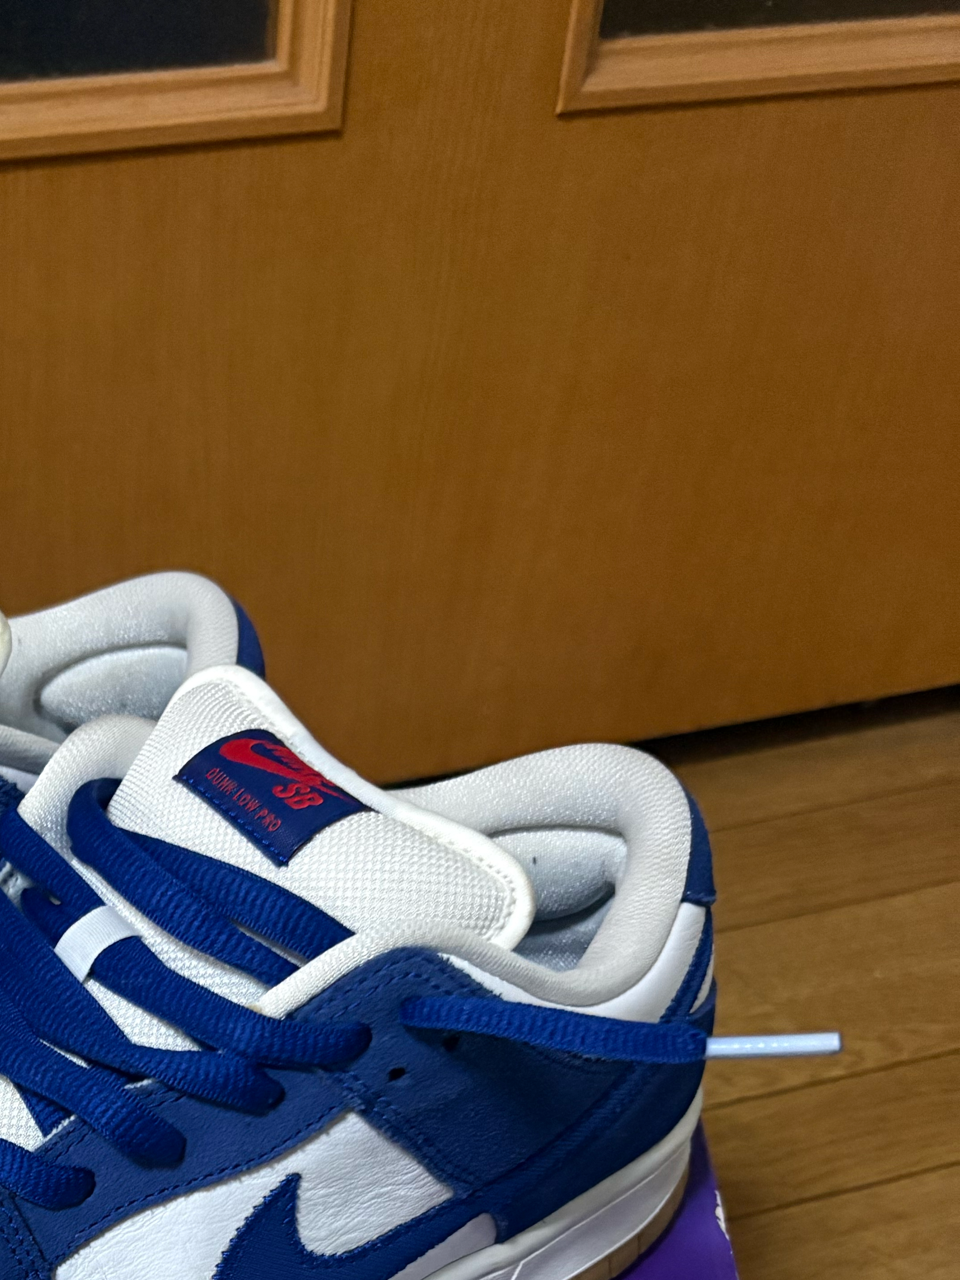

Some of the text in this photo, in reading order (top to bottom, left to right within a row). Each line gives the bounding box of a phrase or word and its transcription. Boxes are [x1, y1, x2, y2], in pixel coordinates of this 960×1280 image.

[232, 787, 262, 813] LOW
[254, 807, 282, 832] PRO
[272, 782, 324, 810] SB
